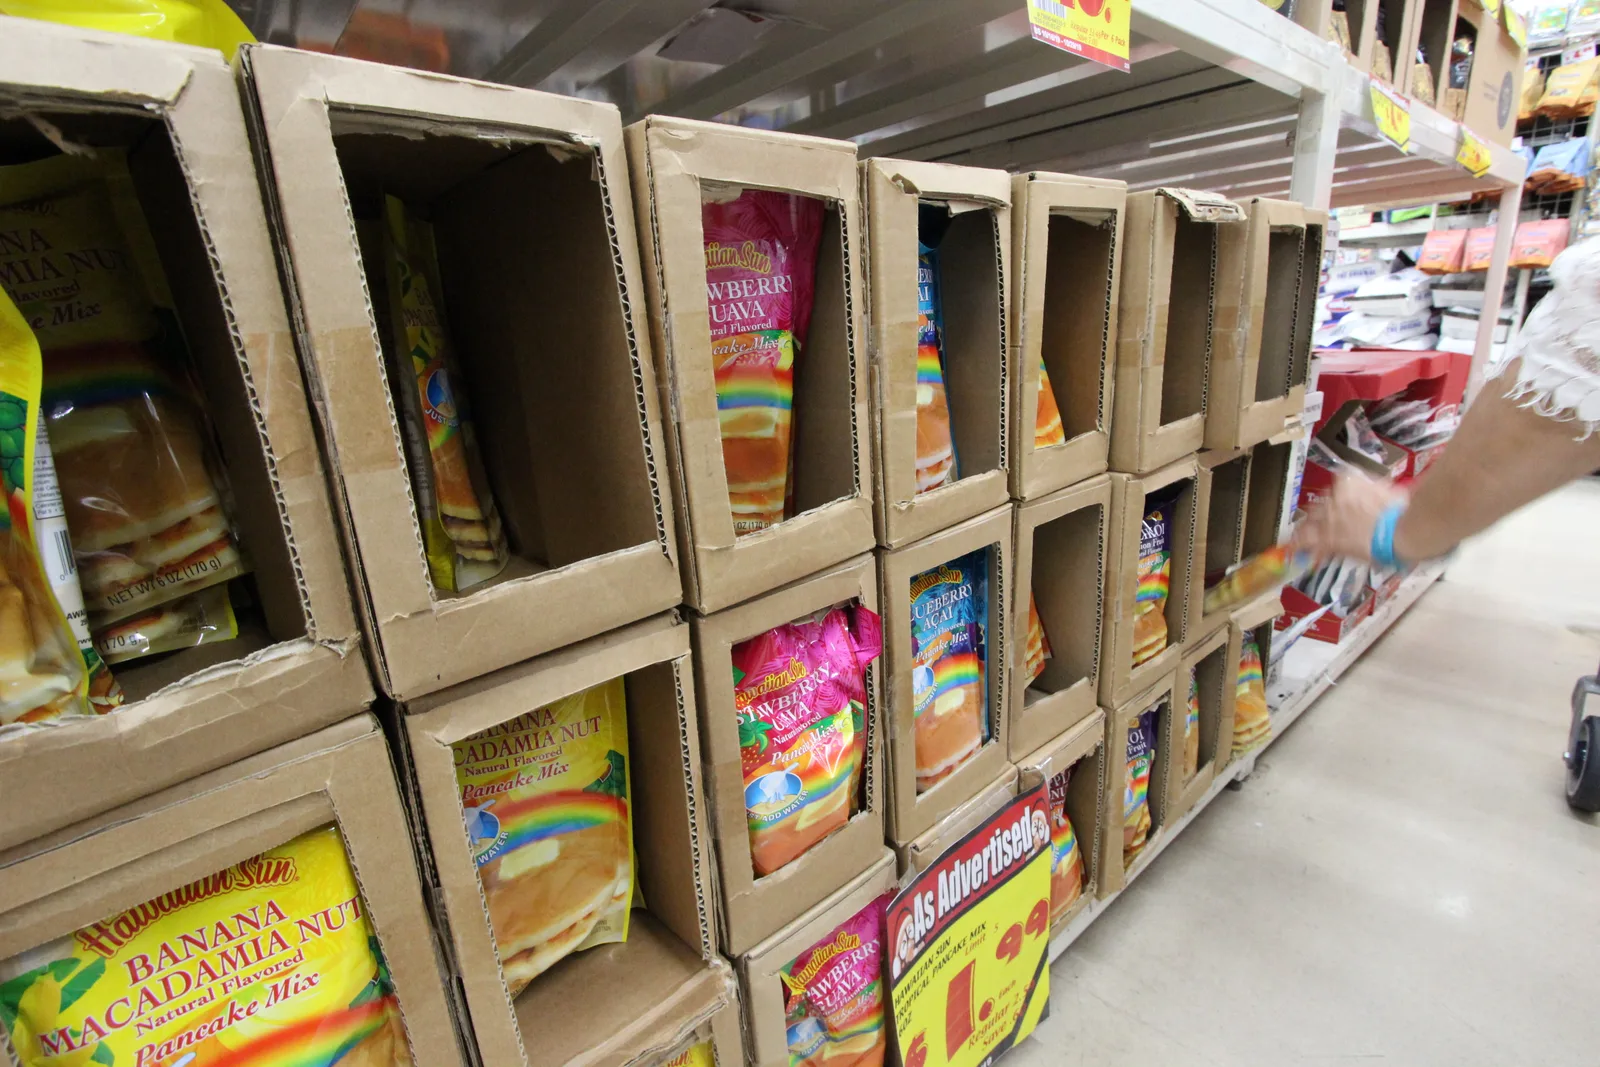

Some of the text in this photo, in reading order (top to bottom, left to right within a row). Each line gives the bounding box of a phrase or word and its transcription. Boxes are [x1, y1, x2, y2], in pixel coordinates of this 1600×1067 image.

[730, 319, 773, 334] Flavored
[424, 407, 446, 426] JUST
[106, 588, 136, 607] NET
[156, 575, 166, 588] 6
[165, 569, 184, 585] OZ
[184, 560, 210, 580] (170
[211, 556, 222, 572] g)
[923, 605, 954, 632] AÇAI
[950, 630, 970, 646] Mix
[560, 715, 603, 742] NUT
[464, 746, 564, 778] Natural Flavored
[1128, 740, 1147, 755] Fruit
[462, 762, 570, 800] Pancake Mix
[762, 812, 782, 822] ADD
[782, 790, 809, 815] WATER
[478, 830, 510, 865] WATER
[230, 853, 298, 890] Sun
[912, 805, 1034, 944] As Advertised
[124, 899, 290, 987] BANANA
[834, 930, 861, 953] Sun
[964, 933, 987, 957] Limit
[36, 896, 363, 1057] MACADAMIA NUT
[894, 936, 952, 1009] HAWAIIAN SUN
[896, 920, 987, 1026] TROPICAL PANCAKE MIX
[135, 948, 305, 1038] Natural Flavored
[135, 968, 321, 1067] Pancake Mix
[968, 1002, 1011, 1051] Regular
[981, 1020, 1007, 1052] Save
